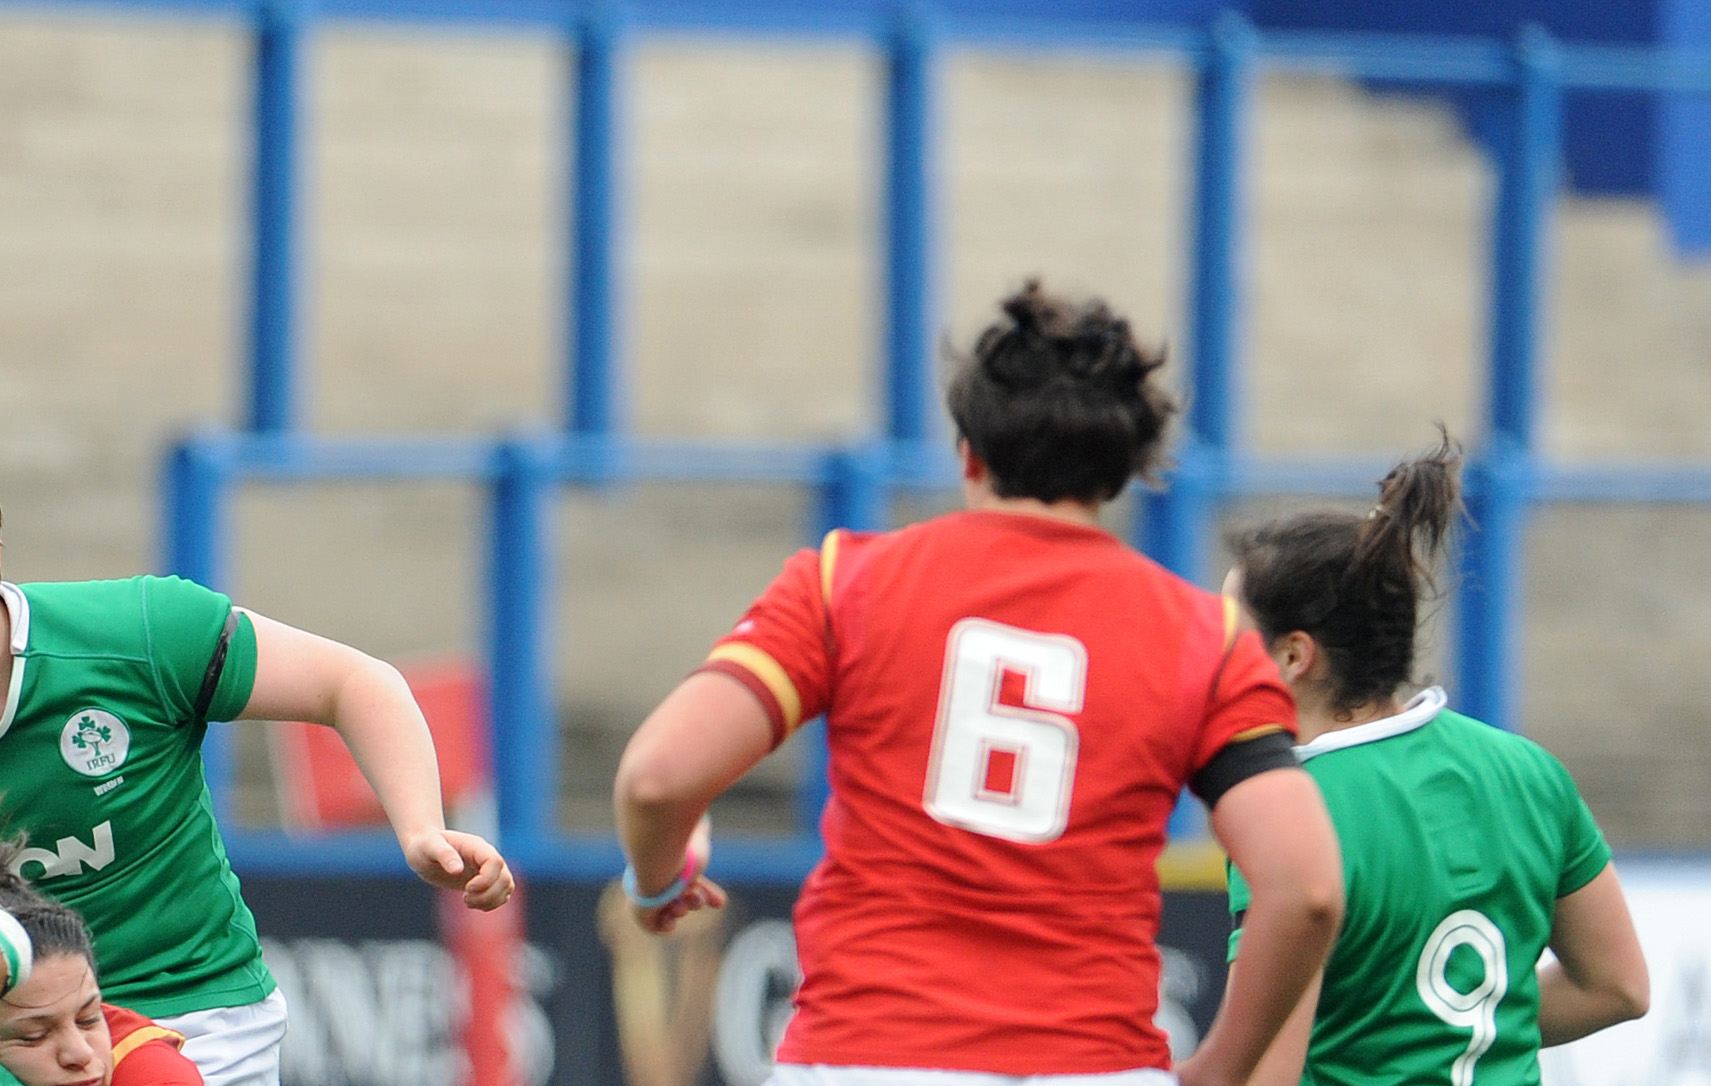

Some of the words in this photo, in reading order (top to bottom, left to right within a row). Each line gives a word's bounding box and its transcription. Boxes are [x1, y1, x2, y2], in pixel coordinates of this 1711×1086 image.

[922, 616, 1088, 846] 6
[86, 753, 116, 771] IRFU
[9, 820, 115, 880] ON
